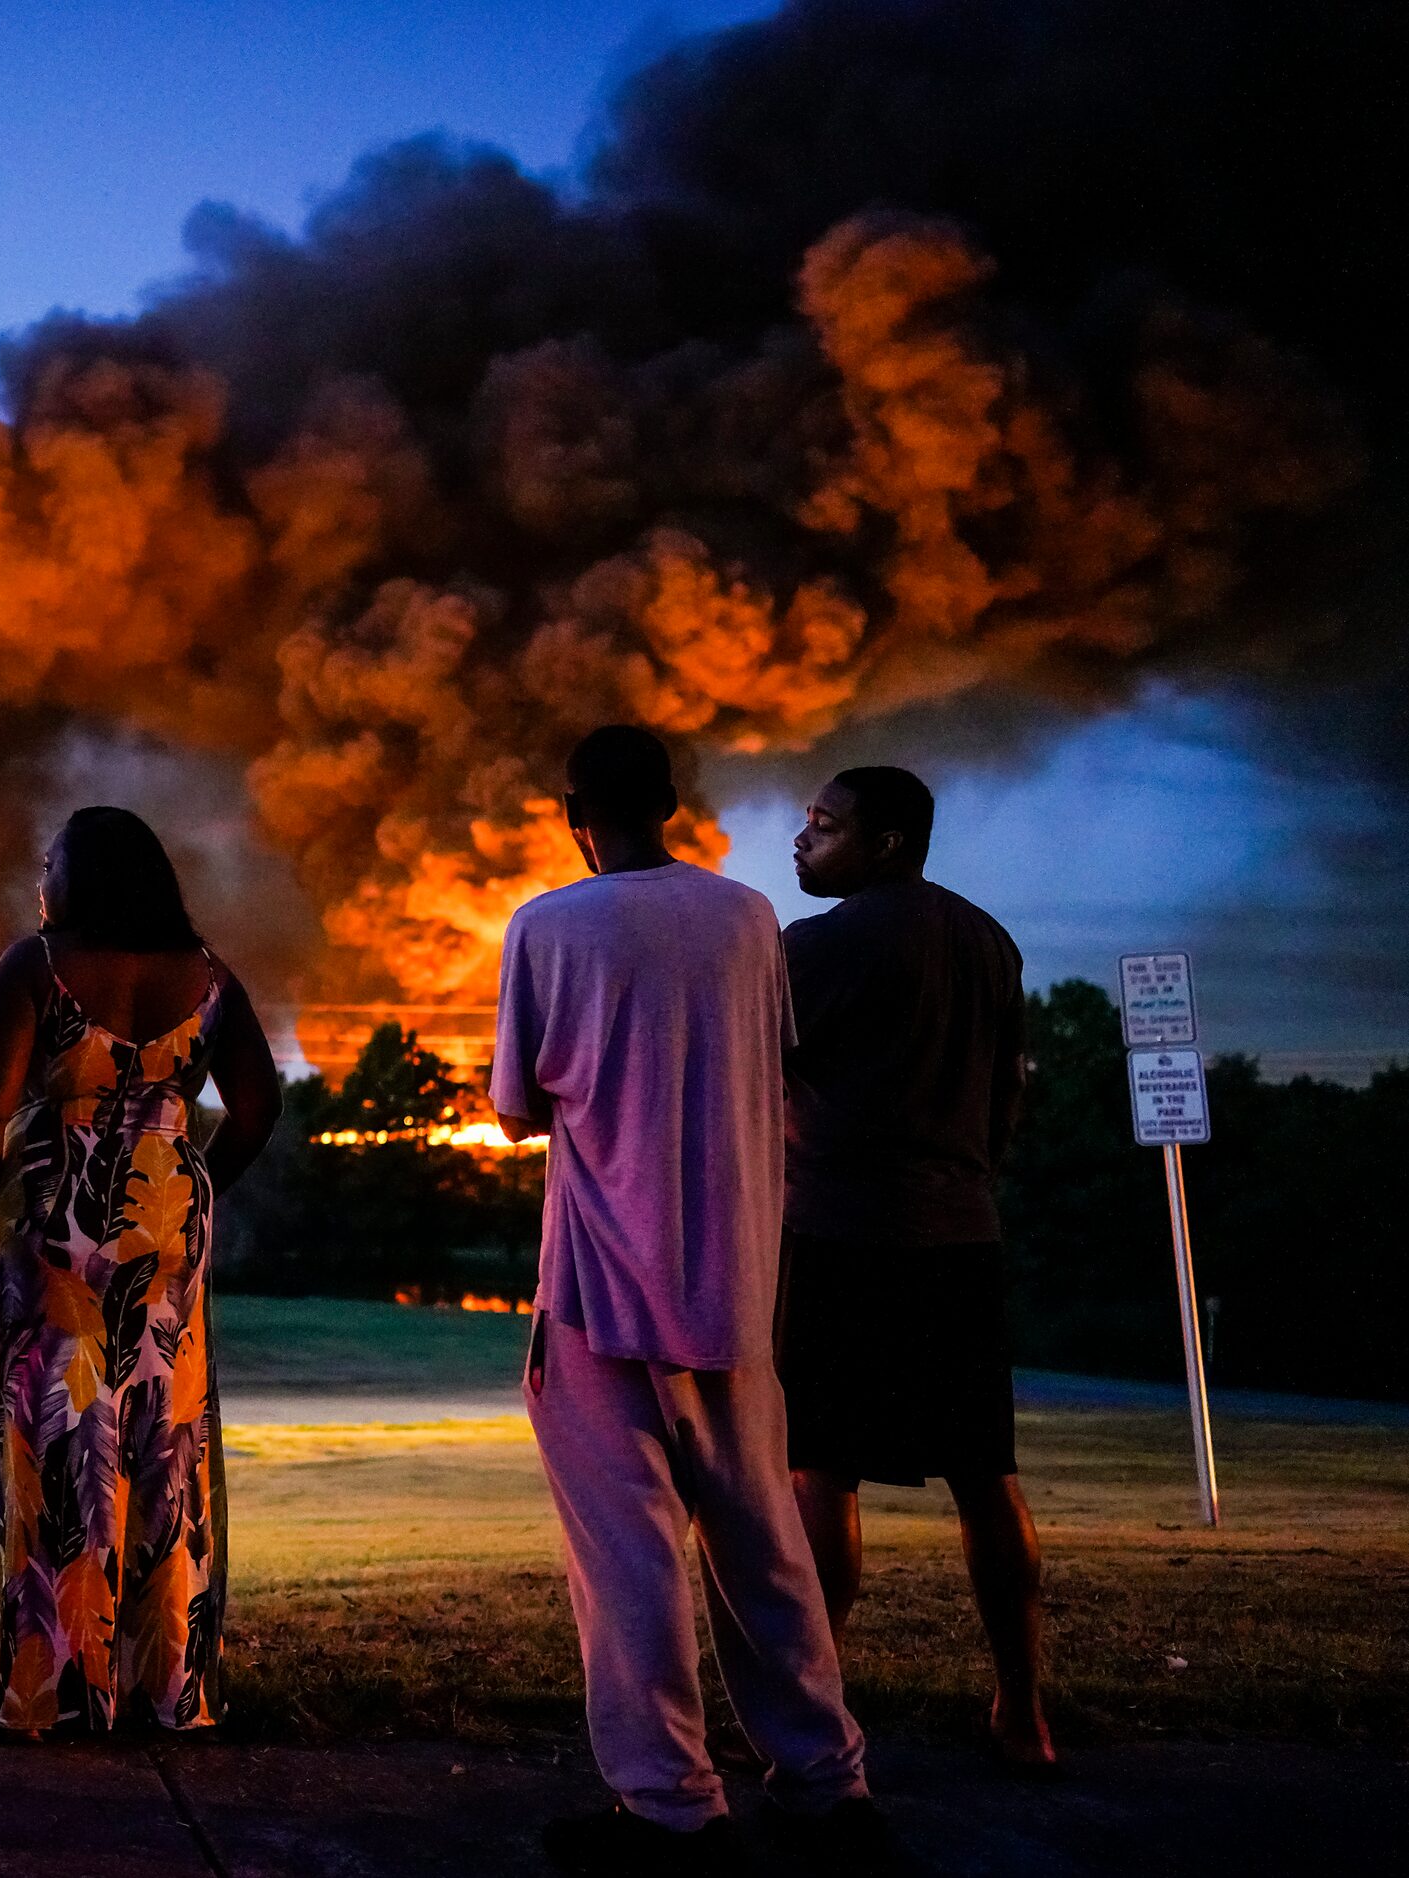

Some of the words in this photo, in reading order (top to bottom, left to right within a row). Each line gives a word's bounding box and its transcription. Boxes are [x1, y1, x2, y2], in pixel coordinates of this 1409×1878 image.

[1138, 1068, 1194, 1080] ALCOHOLIC
[1138, 1080, 1197, 1092] BEVERAGES
[1152, 1095, 1164, 1105] IN
[1166, 1094, 1185, 1105] THE
[1156, 1107, 1184, 1117] PARK
